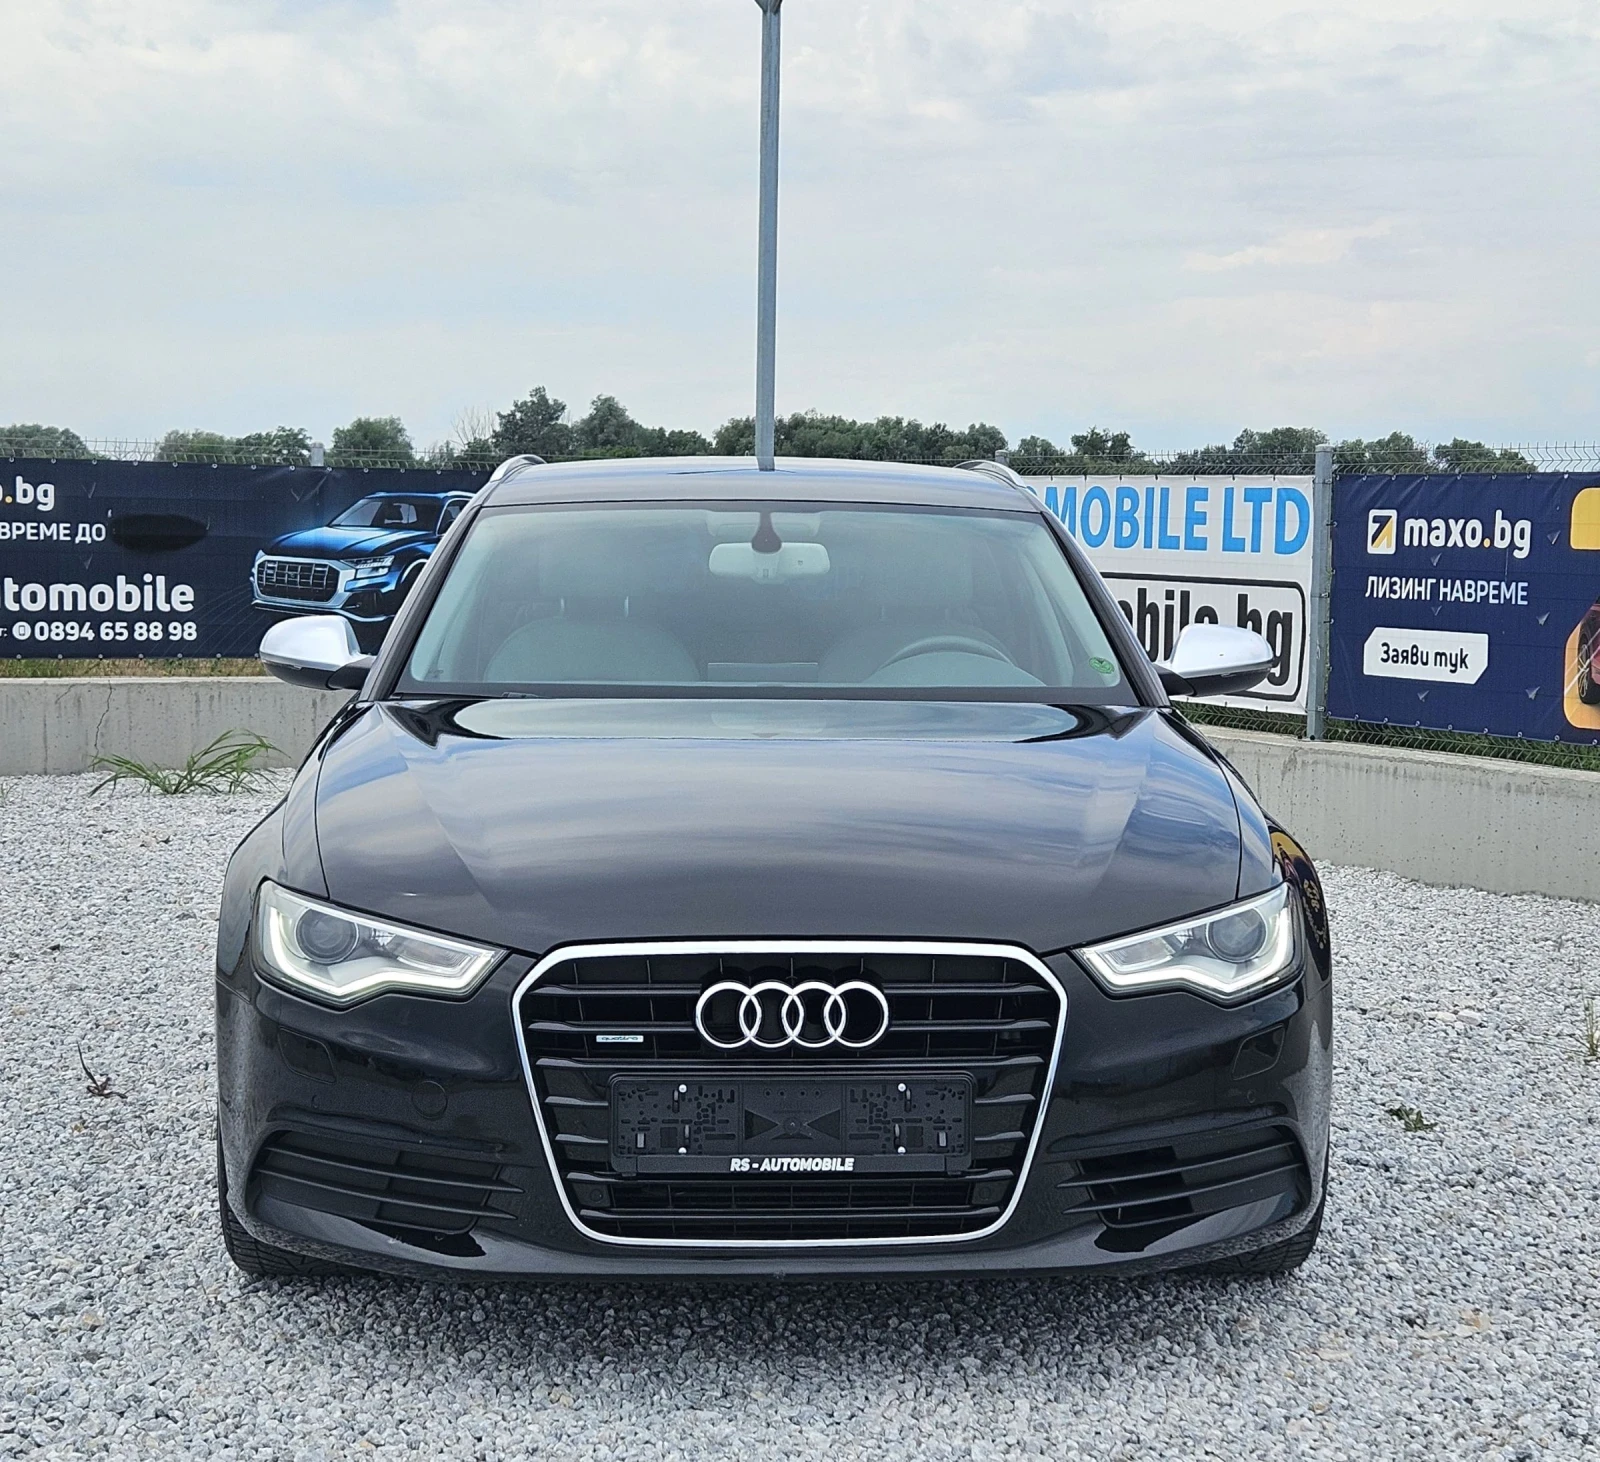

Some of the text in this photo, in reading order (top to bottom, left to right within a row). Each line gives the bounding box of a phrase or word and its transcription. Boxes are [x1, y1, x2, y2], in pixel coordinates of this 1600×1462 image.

[0, 475, 55, 512] .bg
[0, 522, 106, 544] ВРЕМЕ ДО
[1027, 486, 1311, 555] MOBILE LTD
[1403, 509, 1531, 559] maxo.bg
[3, 573, 195, 613] tomobile
[1365, 576, 1529, 605] ЛИЗИНГ НАВРЕМЕ
[34, 621, 95, 641] 0894
[100, 622, 128, 641] 65
[134, 622, 163, 641] 88
[168, 622, 197, 641] 98
[1380, 642, 1469, 673] Заяви тук
